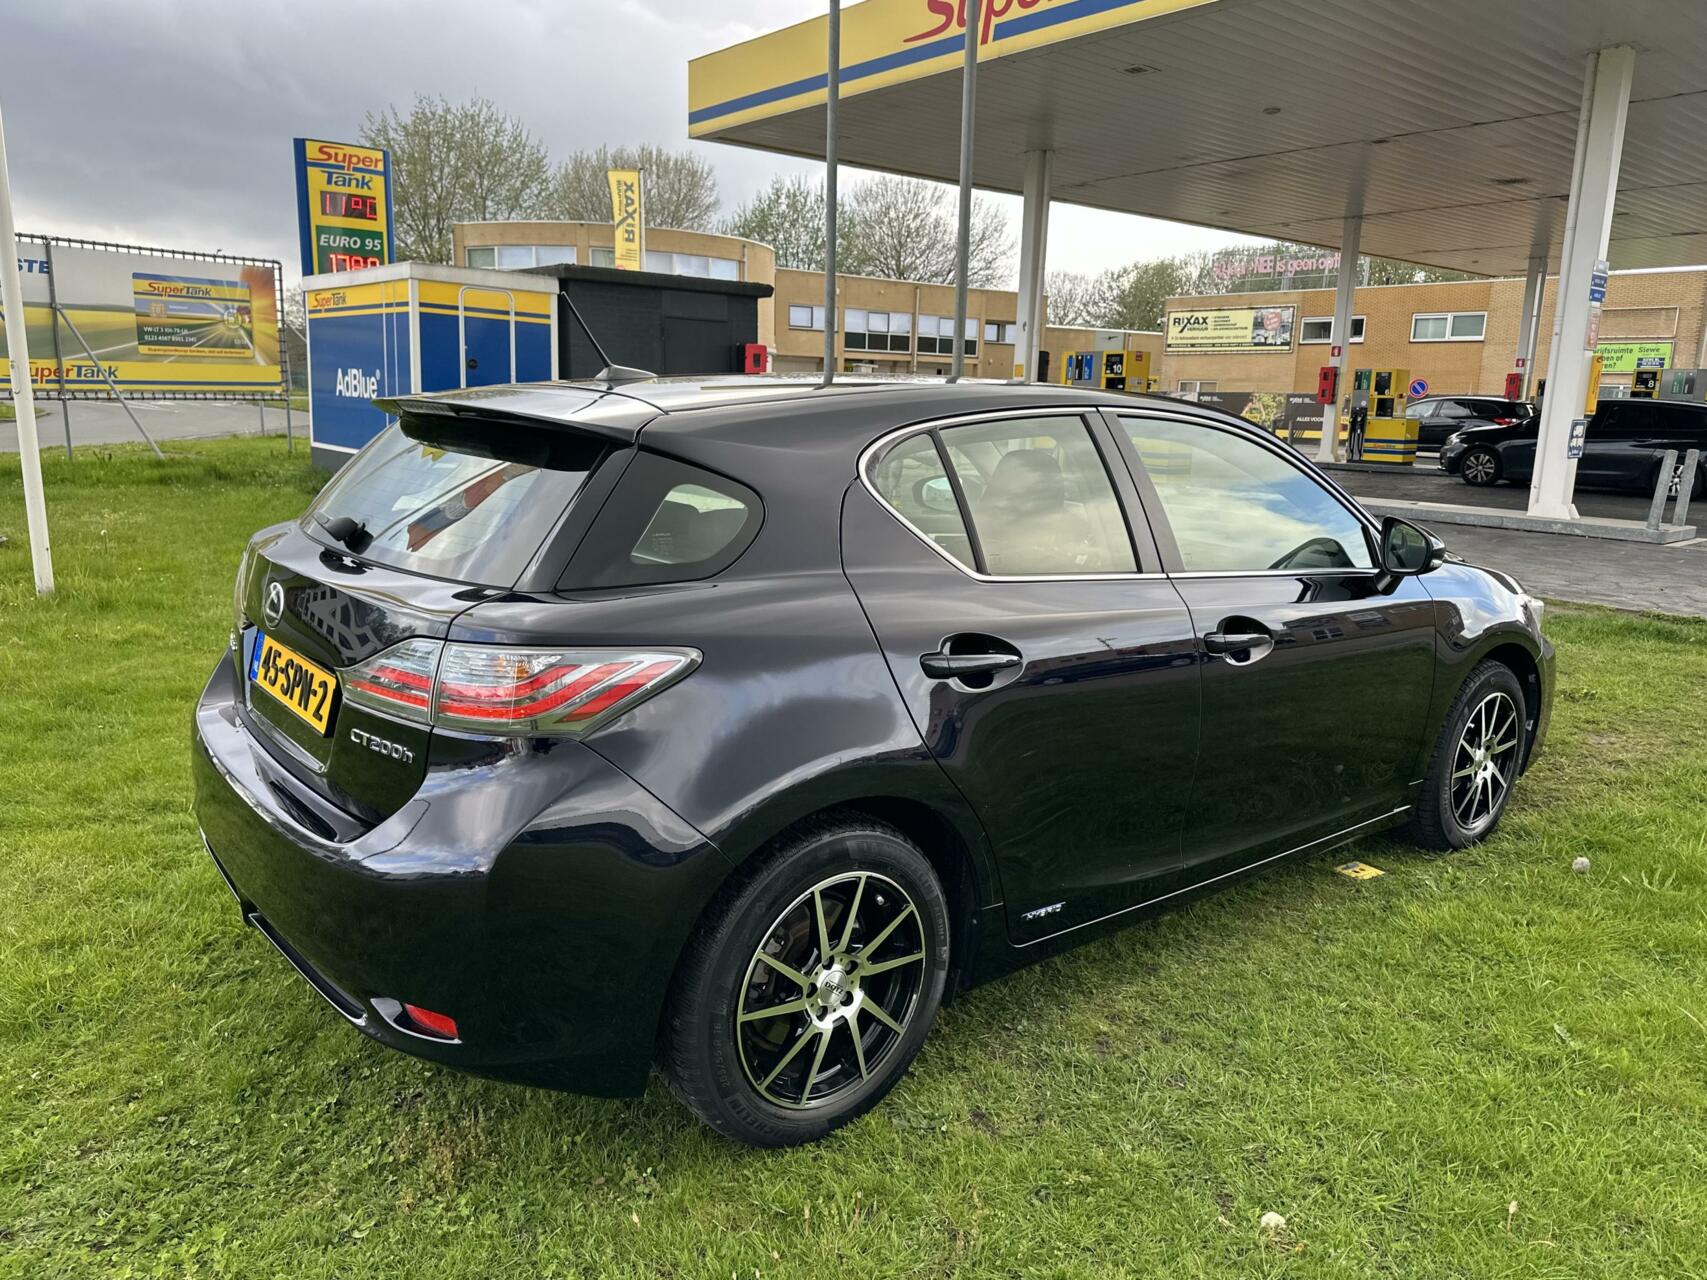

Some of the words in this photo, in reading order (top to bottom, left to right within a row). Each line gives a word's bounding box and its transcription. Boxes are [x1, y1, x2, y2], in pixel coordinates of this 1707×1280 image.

[307, 144, 383, 171] Super
[320, 169, 373, 190] Tank
[320, 234, 361, 249] EURO
[364, 238, 382, 251] 95
[148, 281, 213, 298] SuperTank
[1112, 364, 1122, 374] 10
[260, 645, 329, 723] 45-SPN-2
[824, 981, 844, 994] DOTZ
